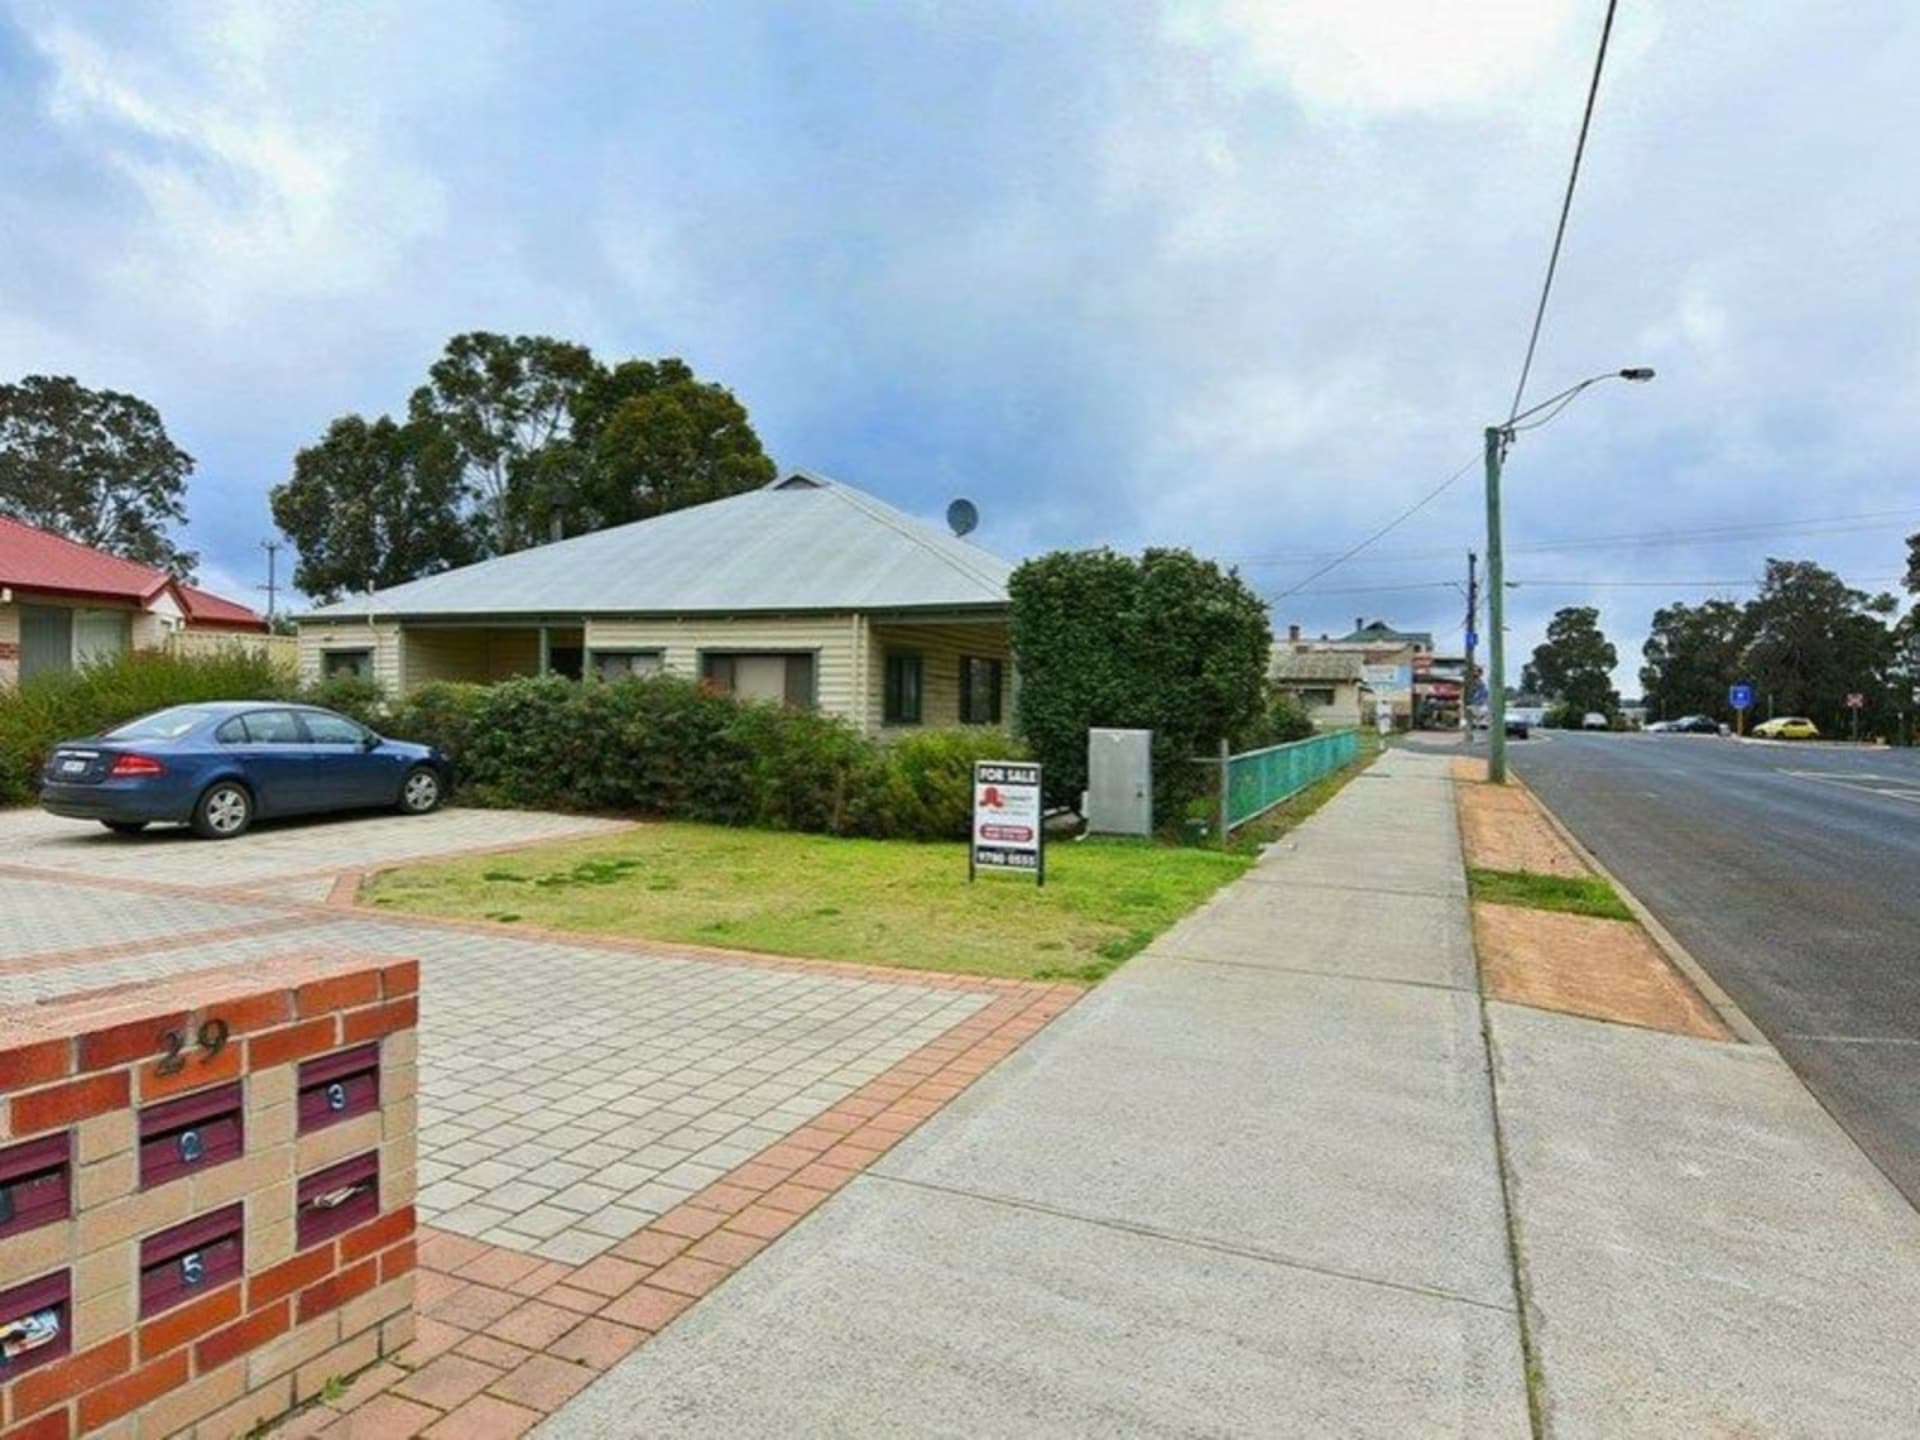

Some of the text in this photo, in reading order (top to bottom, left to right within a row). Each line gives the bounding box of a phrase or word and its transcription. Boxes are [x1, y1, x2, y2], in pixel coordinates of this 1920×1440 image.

[979, 767, 1036, 783] FOR SALE
[154, 1018, 229, 1078] 29
[327, 1082, 346, 1110] 3
[179, 1130, 203, 1162] 2
[181, 1252, 204, 1284] 5
